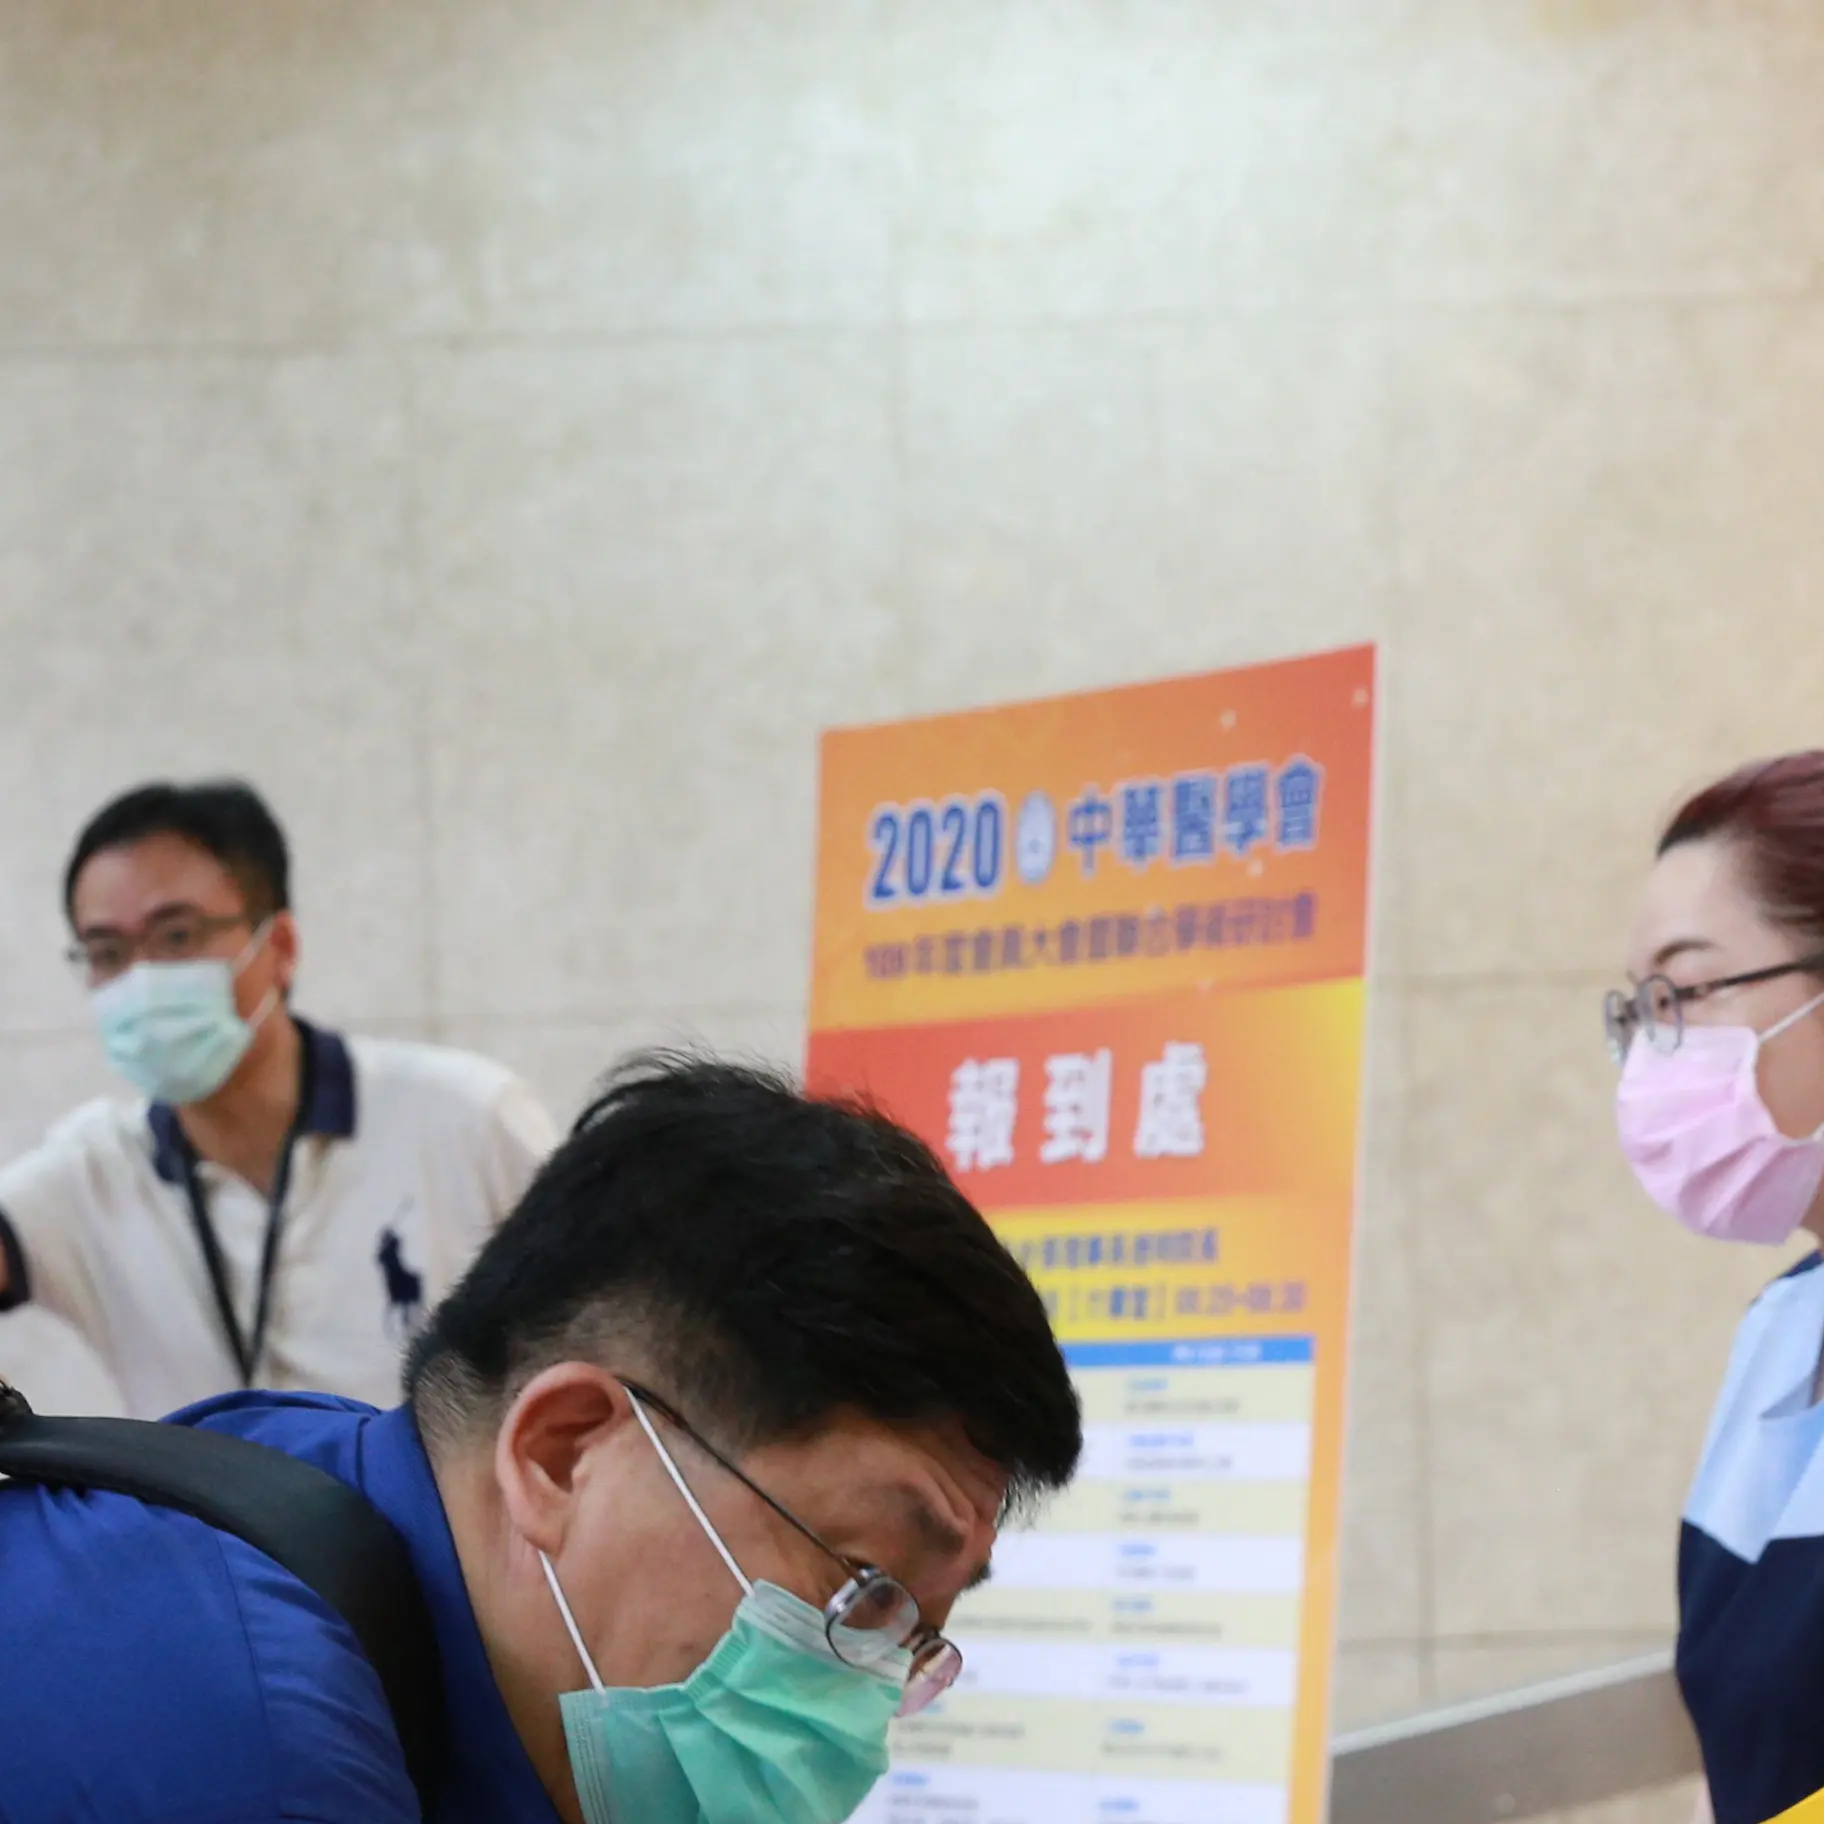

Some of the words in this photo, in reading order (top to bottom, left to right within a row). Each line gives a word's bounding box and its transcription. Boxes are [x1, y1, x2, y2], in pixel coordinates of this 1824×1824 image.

[866, 793, 1005, 905] 2020
[1066, 754, 1325, 877] 中華醫學會
[945, 1040, 1208, 1173] 報到處
